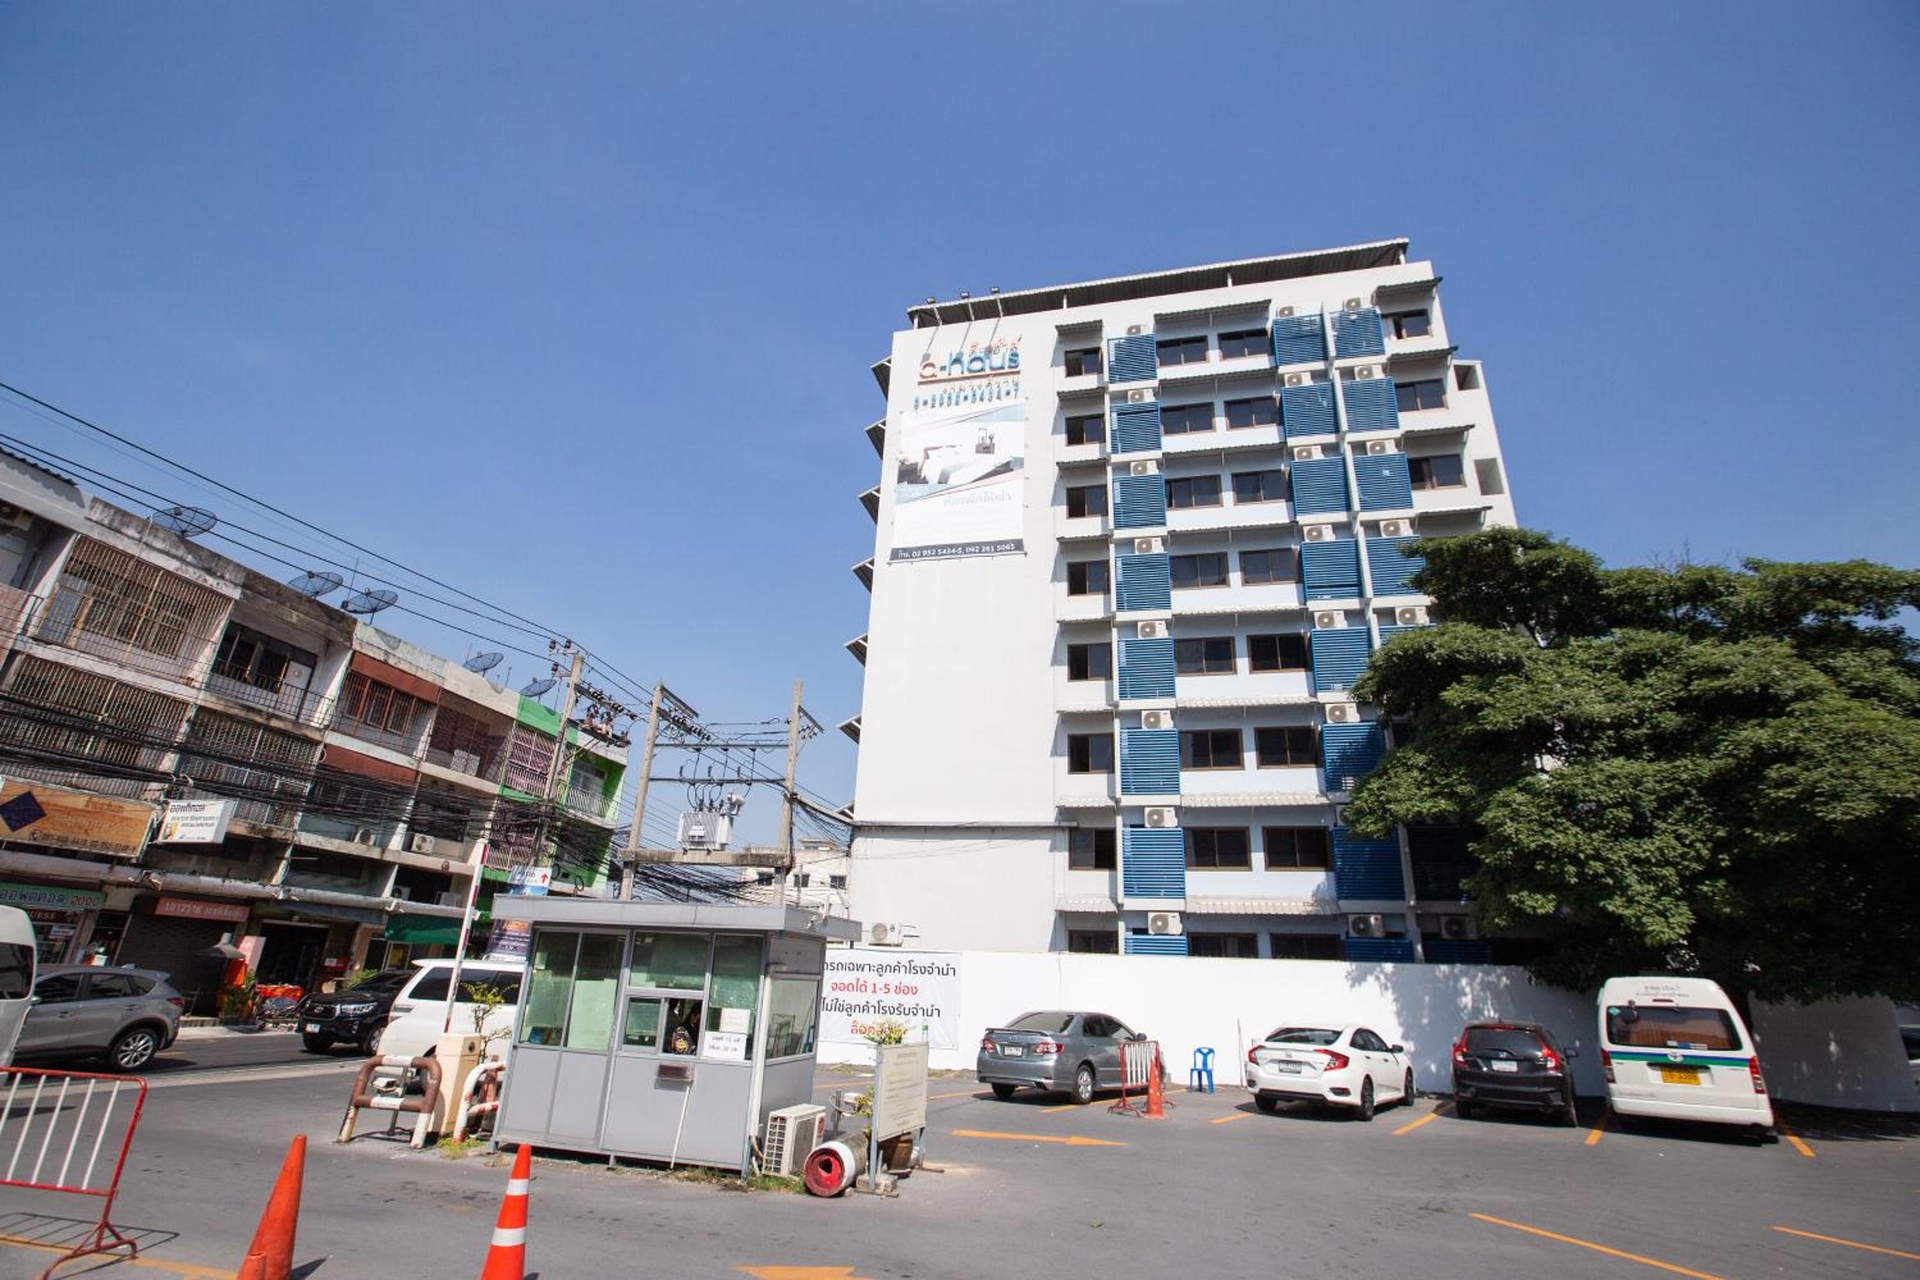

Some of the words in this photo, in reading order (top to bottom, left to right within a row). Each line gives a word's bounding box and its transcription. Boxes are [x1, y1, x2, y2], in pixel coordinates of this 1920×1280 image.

[69, 895, 99, 906] 2000
[831, 978, 867, 993] จอดได้
[871, 982, 891, 994] 1-5
[894, 981, 918, 995] ช่อง
